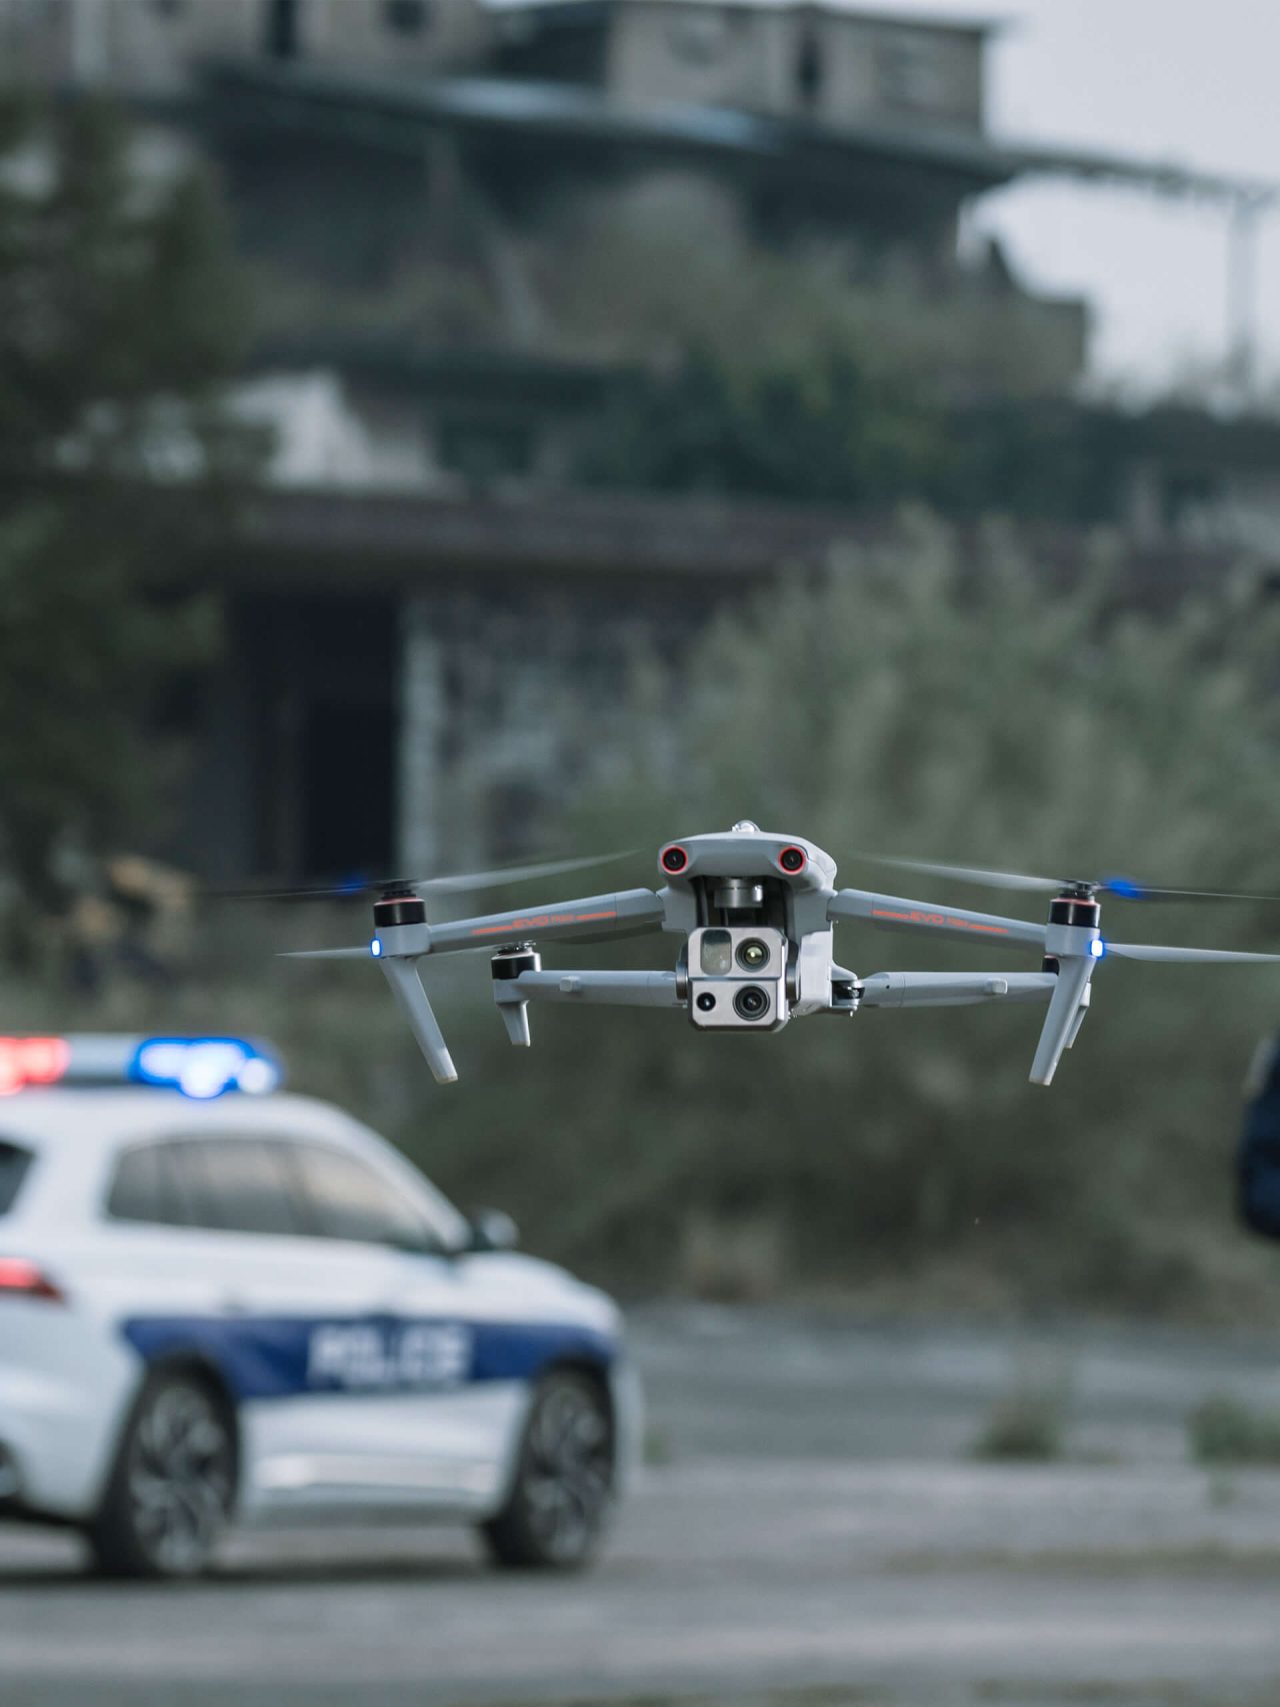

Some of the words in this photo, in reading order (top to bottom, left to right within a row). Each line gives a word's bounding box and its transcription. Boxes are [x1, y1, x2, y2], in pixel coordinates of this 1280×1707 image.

[512, 914, 549, 929] EVO
[911, 911, 944, 926] EVO
[307, 1323, 472, 1387] POLICE
